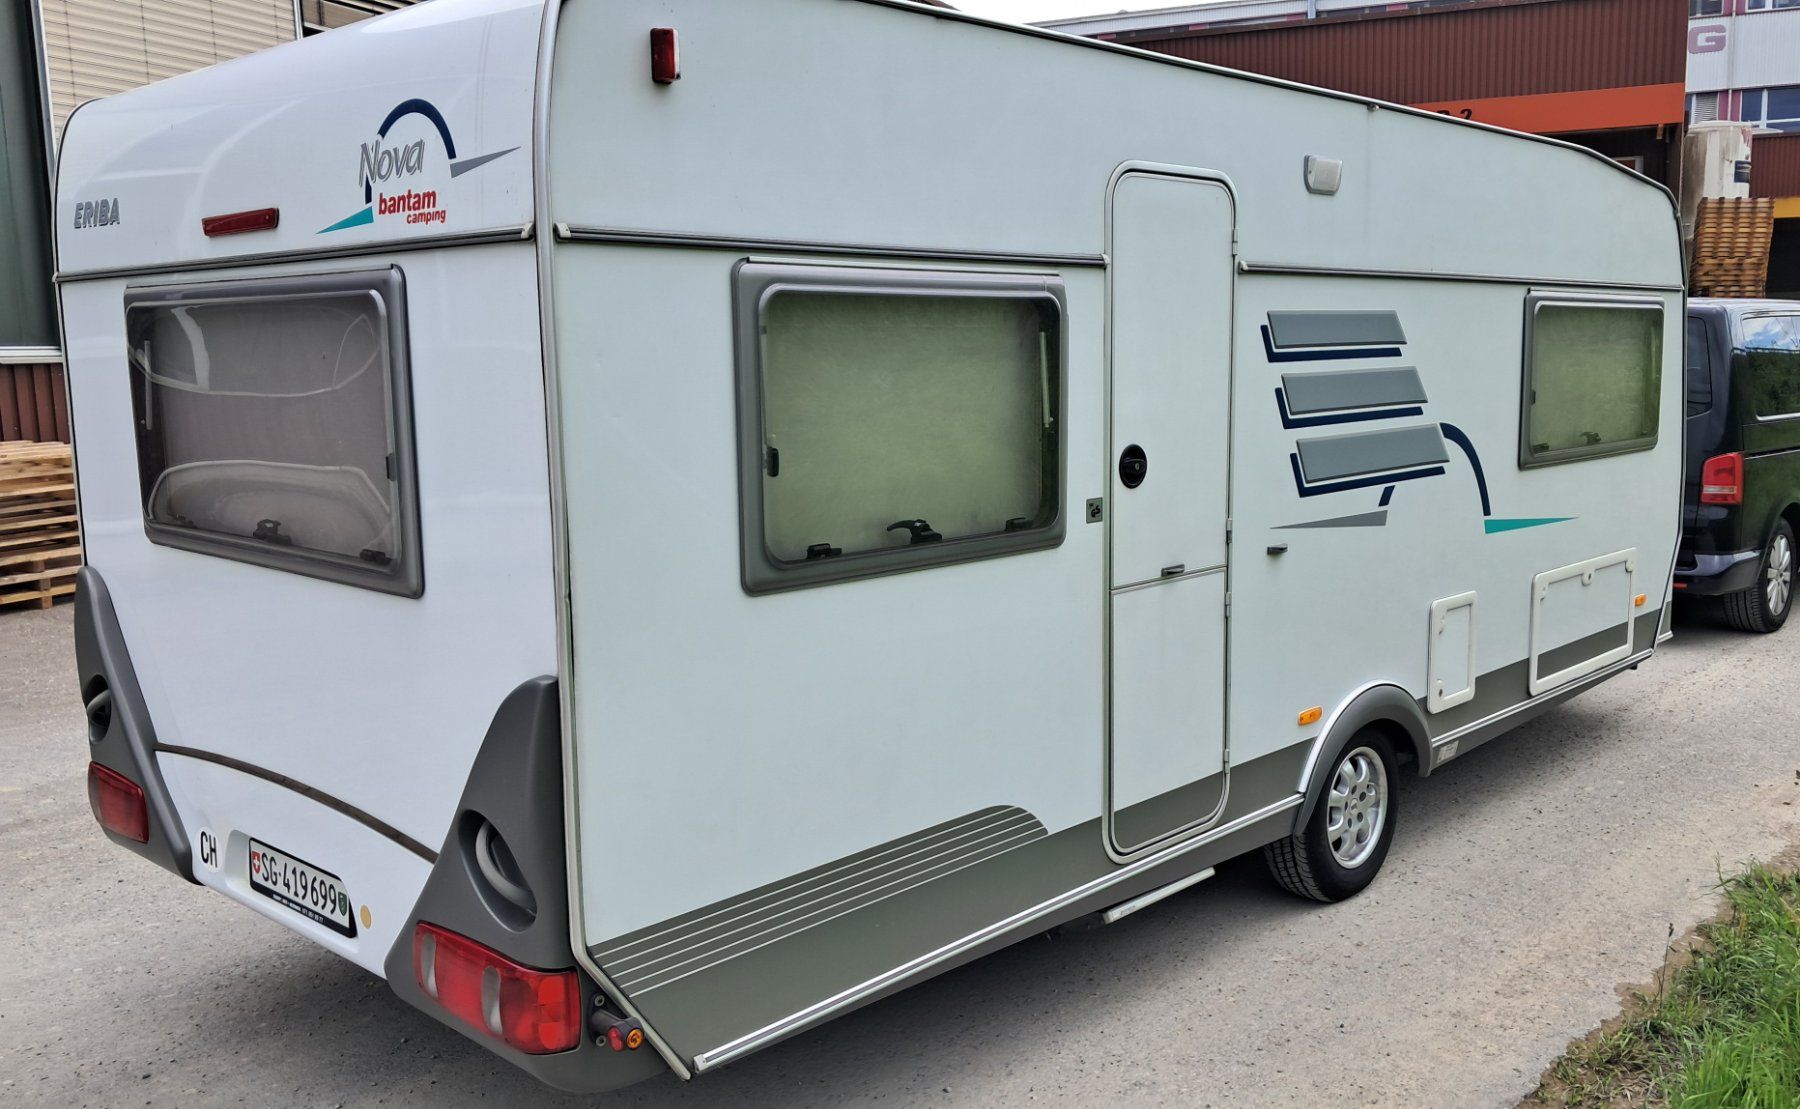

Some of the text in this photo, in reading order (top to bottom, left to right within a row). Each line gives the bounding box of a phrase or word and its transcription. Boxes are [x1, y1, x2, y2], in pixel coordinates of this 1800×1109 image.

[1688, 24, 1726, 54] G
[359, 139, 425, 188] Nova
[74, 198, 120, 229] ERIBA
[378, 189, 437, 215] bantam
[406, 209, 446, 225] camping
[200, 830, 218, 868] CH
